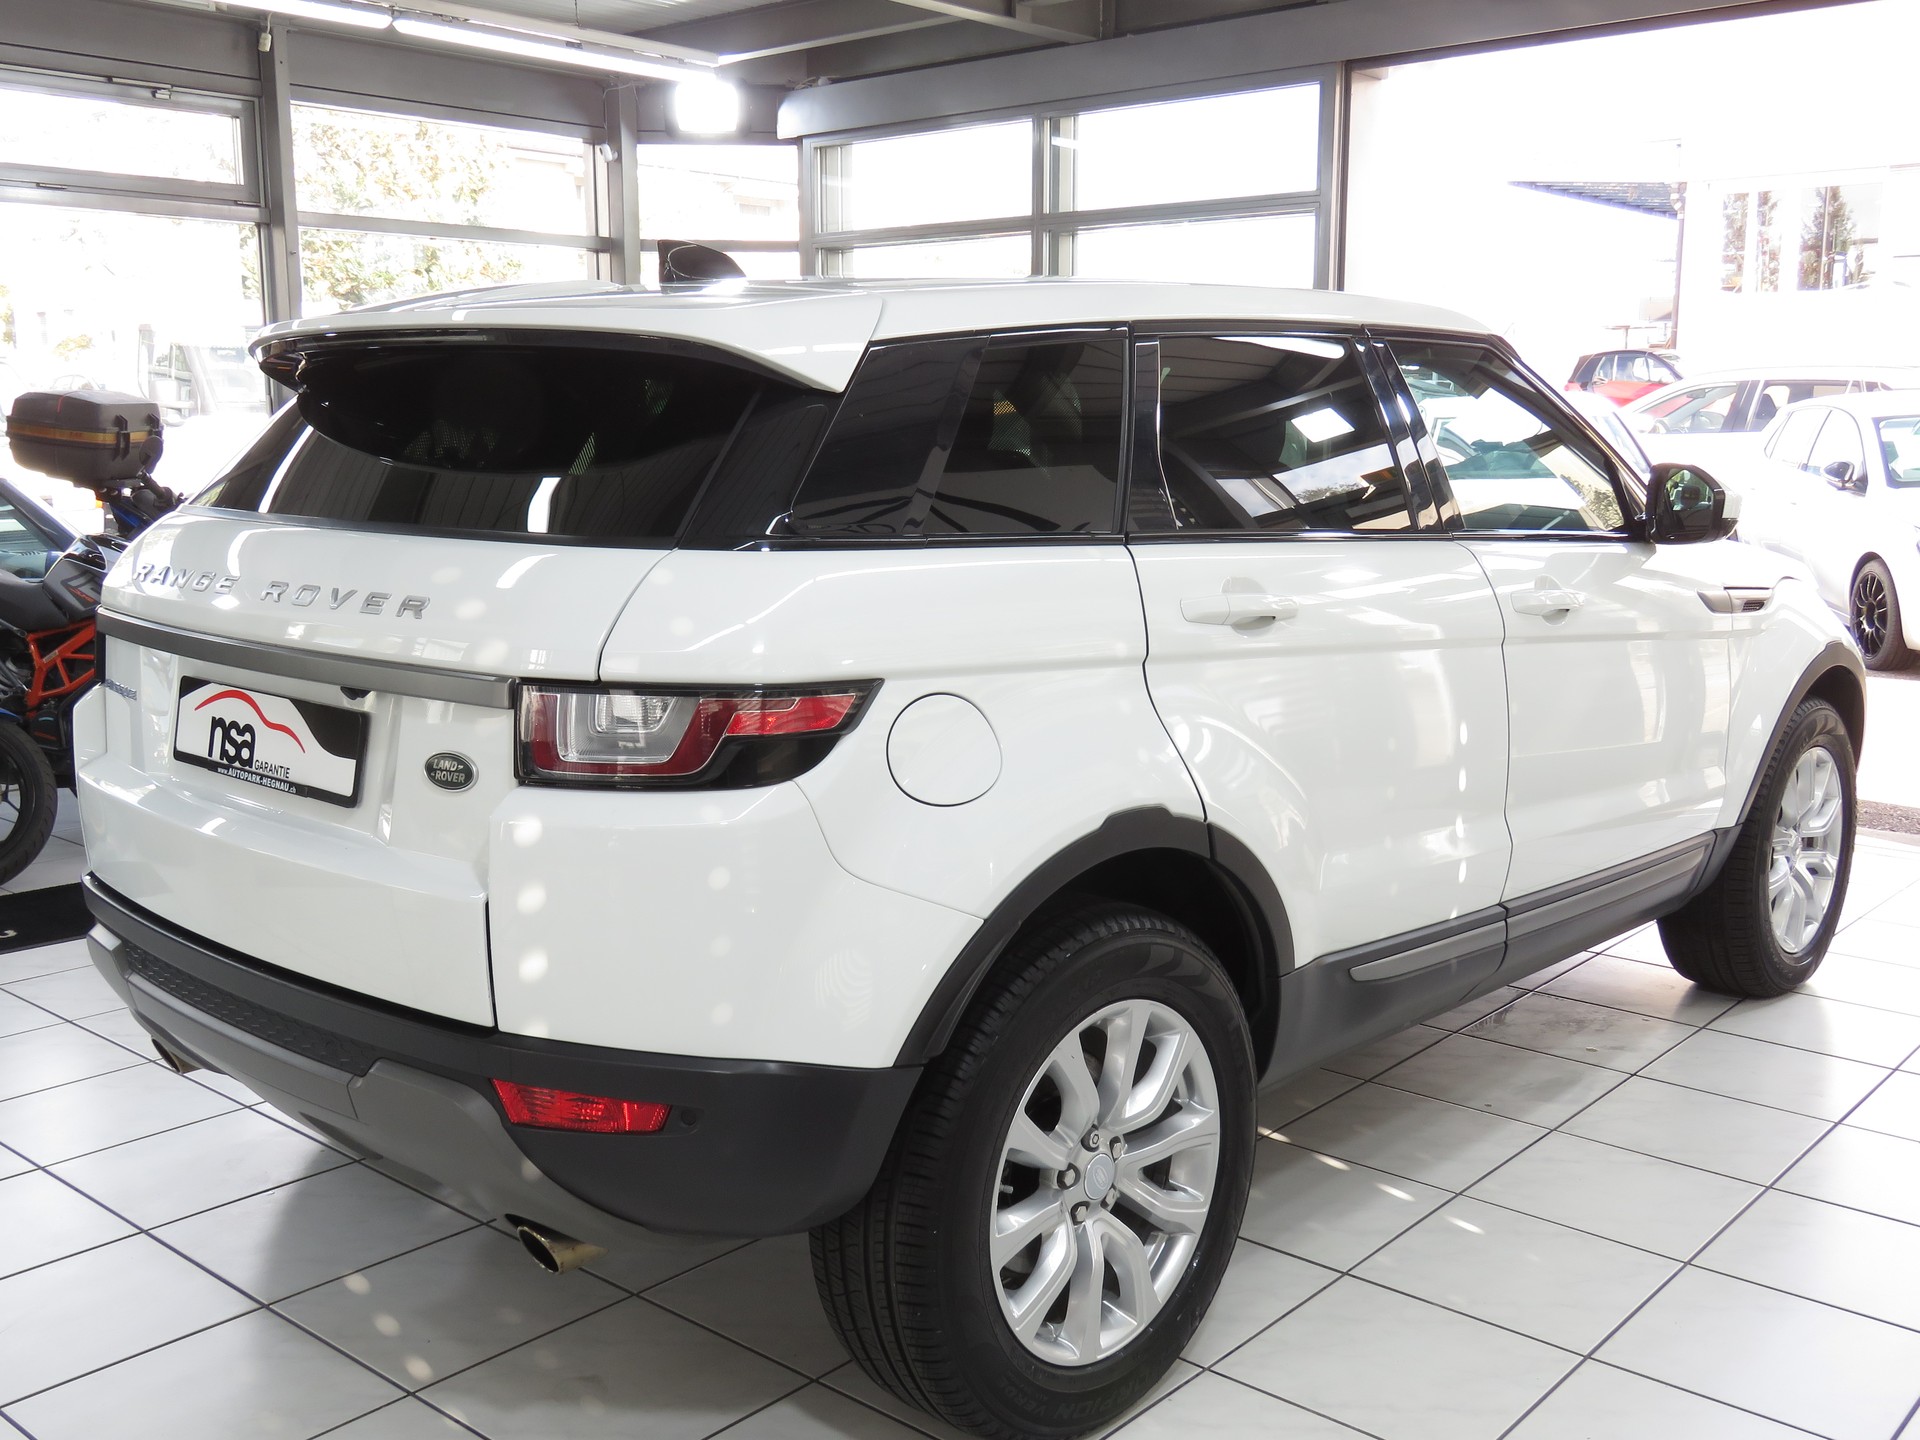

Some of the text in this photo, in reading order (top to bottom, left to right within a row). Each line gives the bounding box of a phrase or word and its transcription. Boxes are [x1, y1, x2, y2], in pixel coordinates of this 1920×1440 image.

[132, 562, 431, 620] RANGE ROVER
[207, 715, 256, 769] nsa
[254, 759, 291, 779] GARANTIE
[432, 758, 458, 771] LAND
[435, 769, 466, 783] ROVER
[217, 766, 297, 794] www.AUTOPARK-HEGNAU.ch
